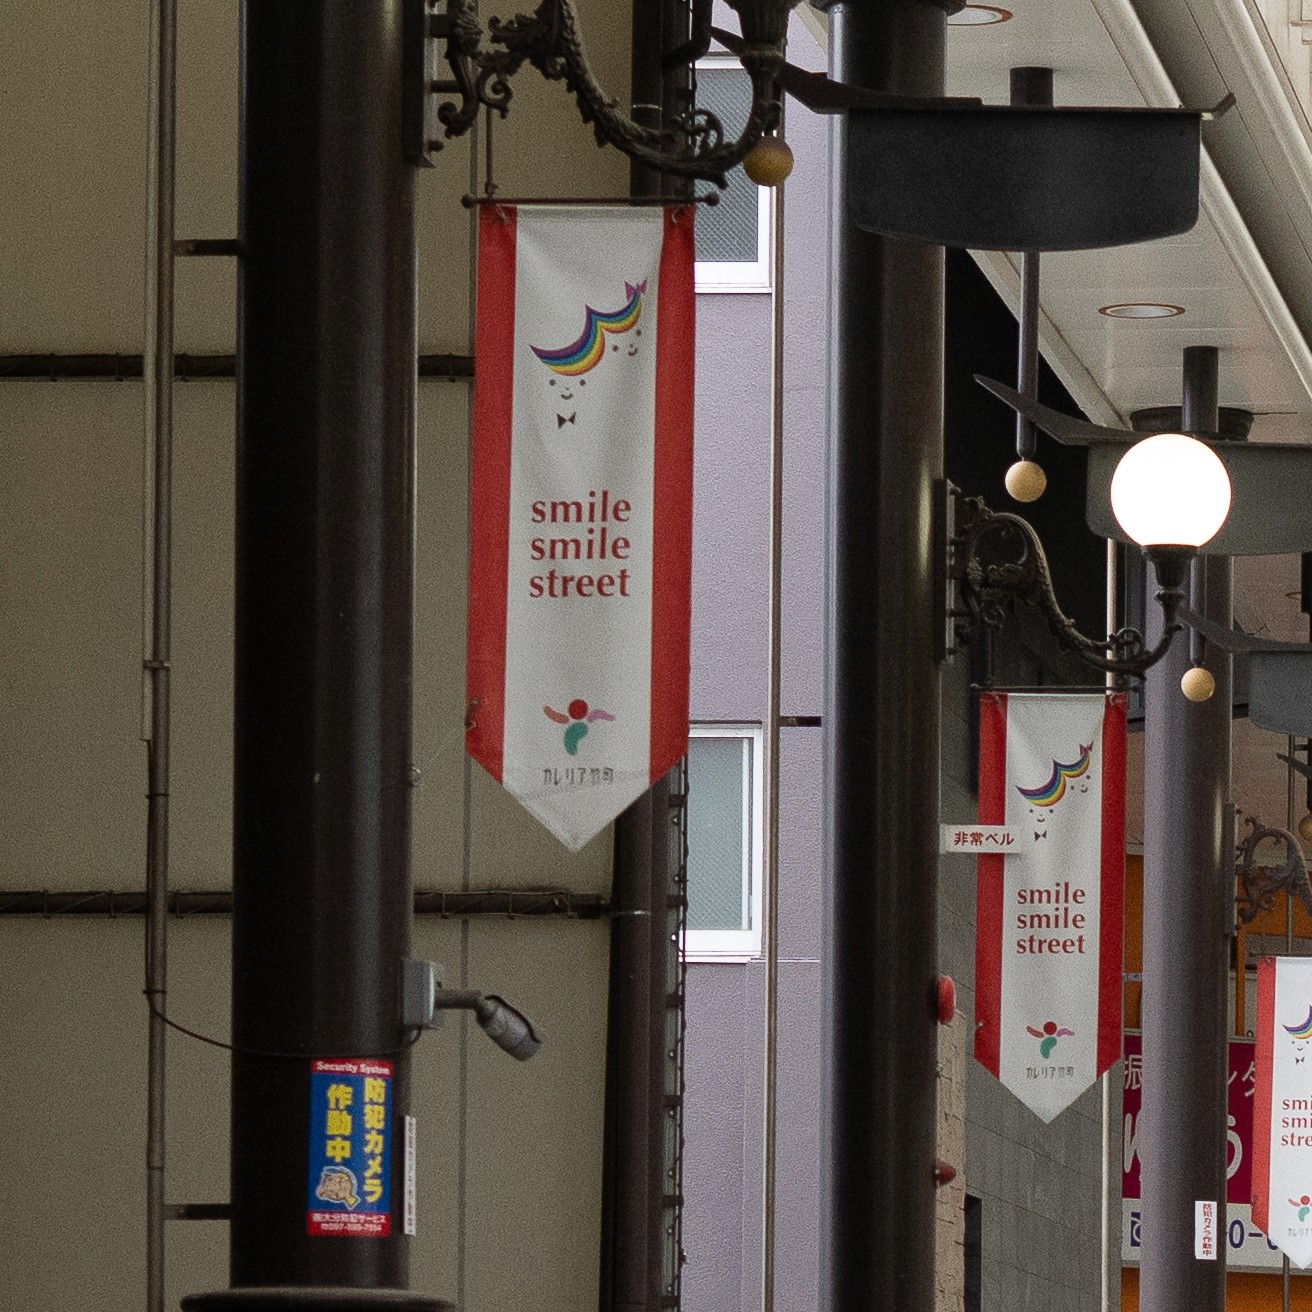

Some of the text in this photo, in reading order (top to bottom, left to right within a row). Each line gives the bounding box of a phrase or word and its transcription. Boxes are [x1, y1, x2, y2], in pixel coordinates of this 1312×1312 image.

[529, 489, 632, 523] smile
[529, 527, 632, 561] smile
[529, 567, 632, 599] street
[953, 830, 1015, 846] 非常ベル
[1016, 881, 1086, 905] smile
[1016, 907, 1086, 930] smile
[1016, 934, 1086, 954] street
[316, 1060, 390, 1076] Security System
[326, 1083, 354, 1163] 作動中
[363, 1076, 386, 1203] 防犯カメラ
